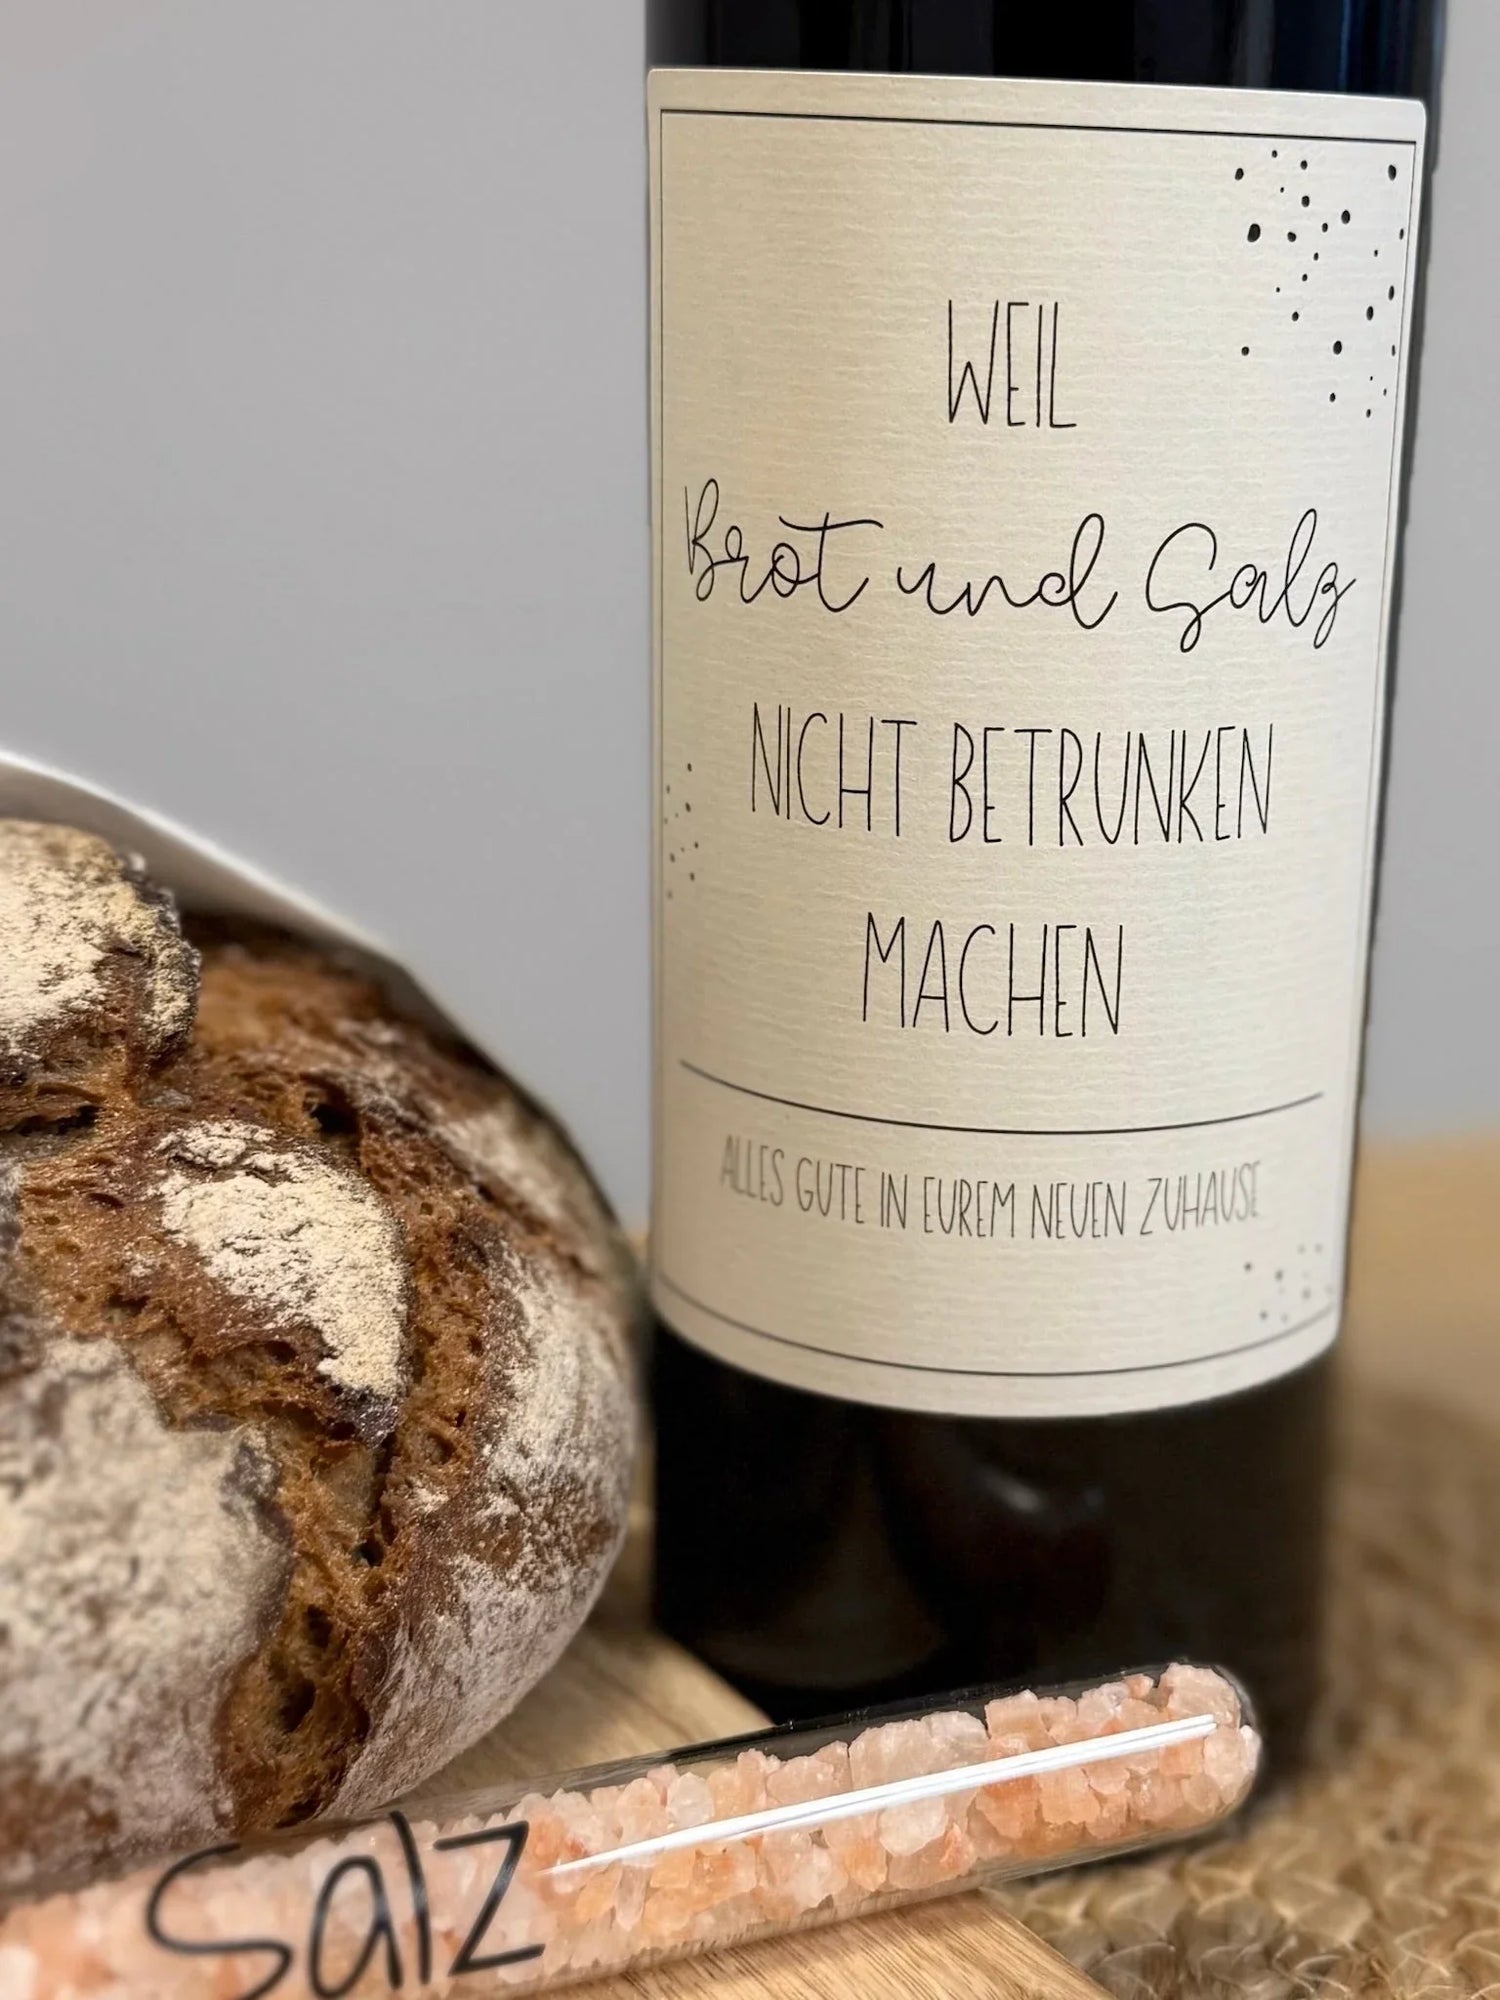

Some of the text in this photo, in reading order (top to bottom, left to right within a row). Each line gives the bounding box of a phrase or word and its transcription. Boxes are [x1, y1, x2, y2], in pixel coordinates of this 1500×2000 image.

[947, 298, 1078, 430] WEIL
[683, 477, 1358, 654] Brot und Salz
[751, 701, 1274, 848] NICHT BETRUNKEN
[862, 911, 1124, 1039] MACHEN
[720, 1134, 1261, 1240] ALLES GUTE IN EUREM NEUEN ZUHAUSE
